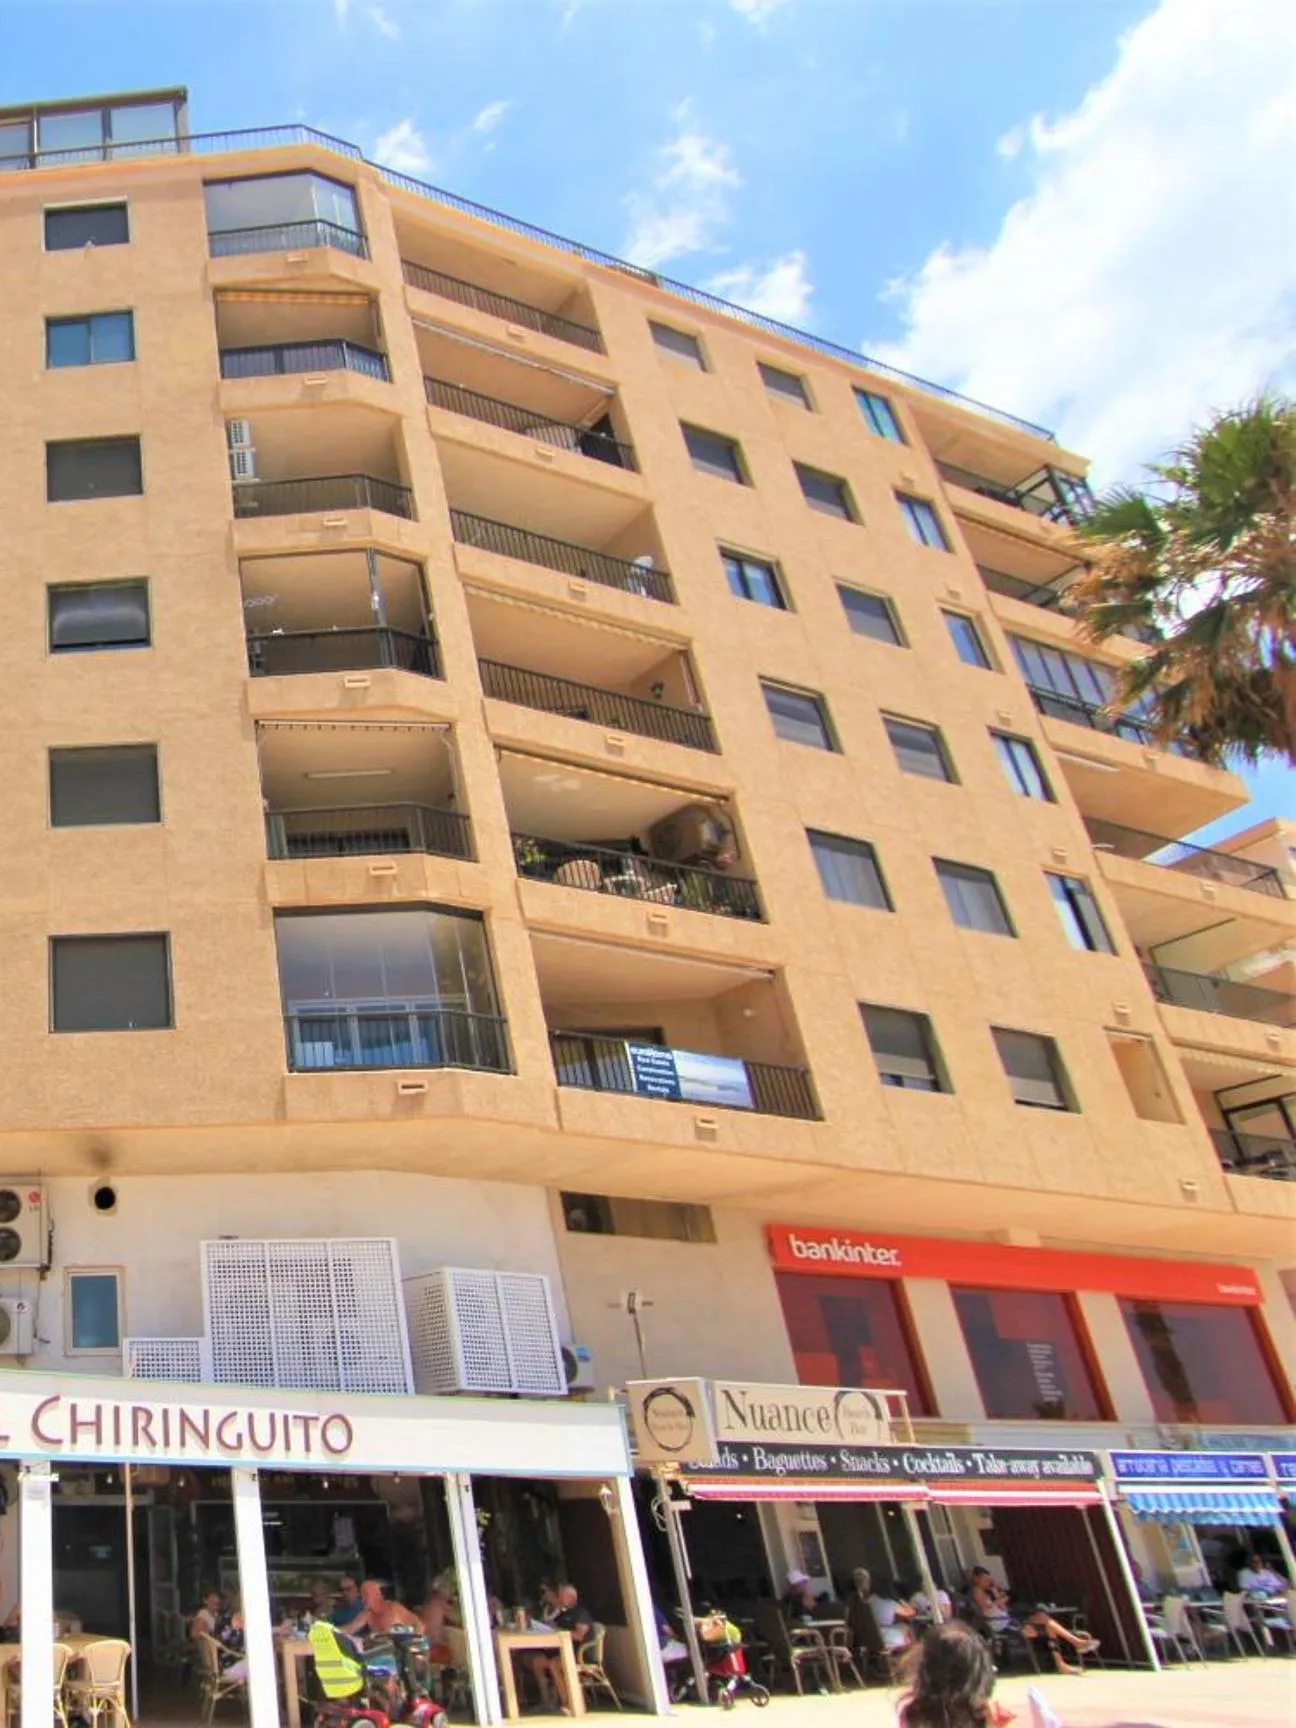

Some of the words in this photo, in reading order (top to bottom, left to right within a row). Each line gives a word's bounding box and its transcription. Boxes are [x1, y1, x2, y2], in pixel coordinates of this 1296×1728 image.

[30, 1394, 354, 1454] CHIRINGUITO
[721, 1389, 830, 1434] Nuance
[752, 1446, 828, 1477] Baguettes
[840, 1450, 891, 1473] Snacks
[903, 1452, 966, 1475] Cocktails
